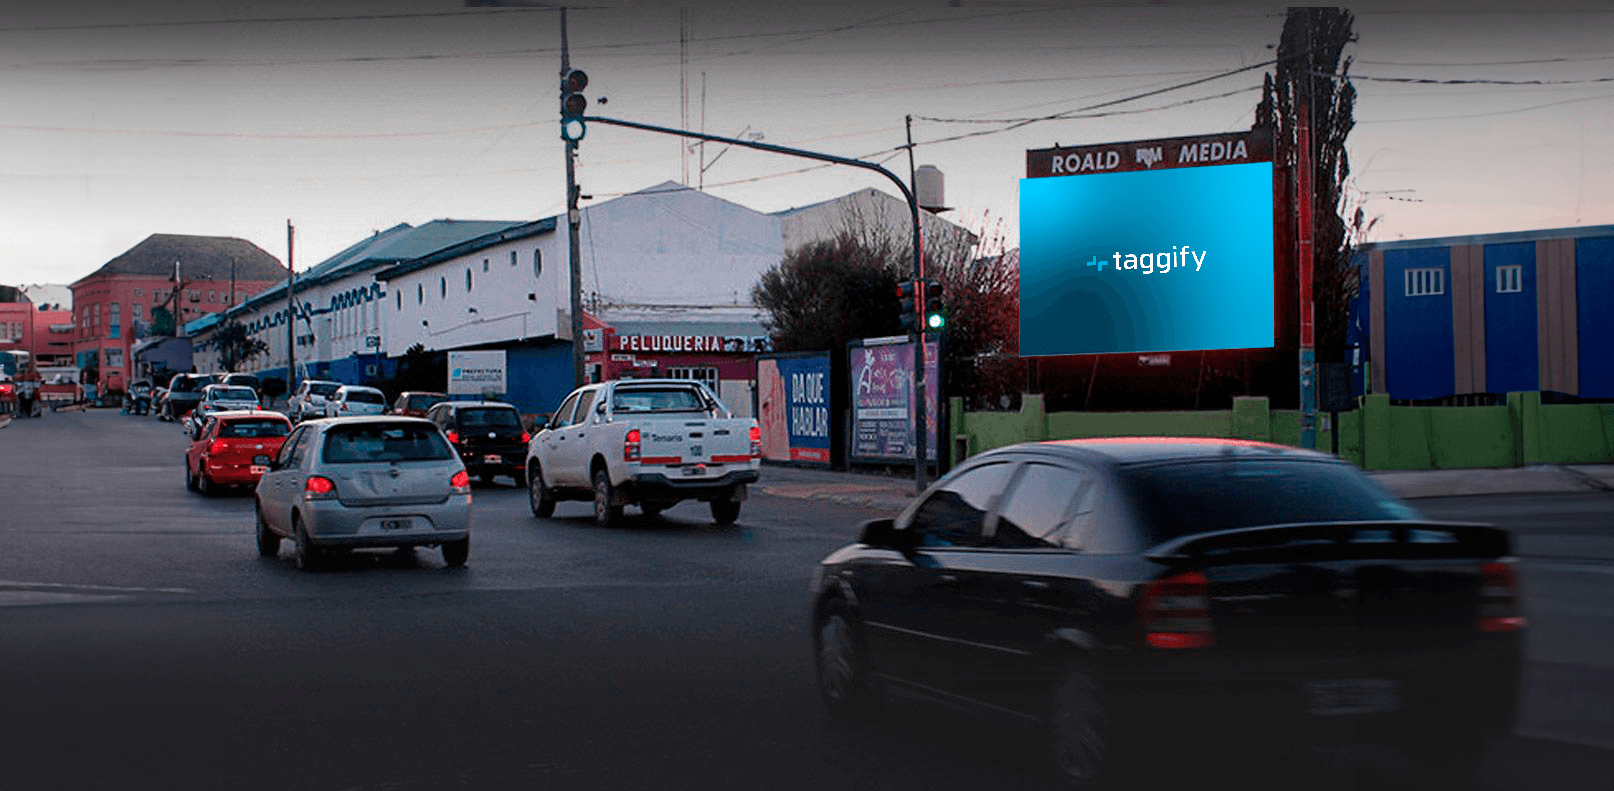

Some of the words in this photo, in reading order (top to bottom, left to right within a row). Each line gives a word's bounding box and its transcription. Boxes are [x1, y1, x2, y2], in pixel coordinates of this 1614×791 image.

[1051, 152, 1120, 173] ROALD
[1178, 140, 1248, 163] MEDIA
[1112, 245, 1207, 275] taggify
[620, 335, 720, 351] PELUQUERIA
[792, 373, 806, 403] DA
[806, 373, 824, 404] QUE
[792, 407, 828, 437] HABLAR
